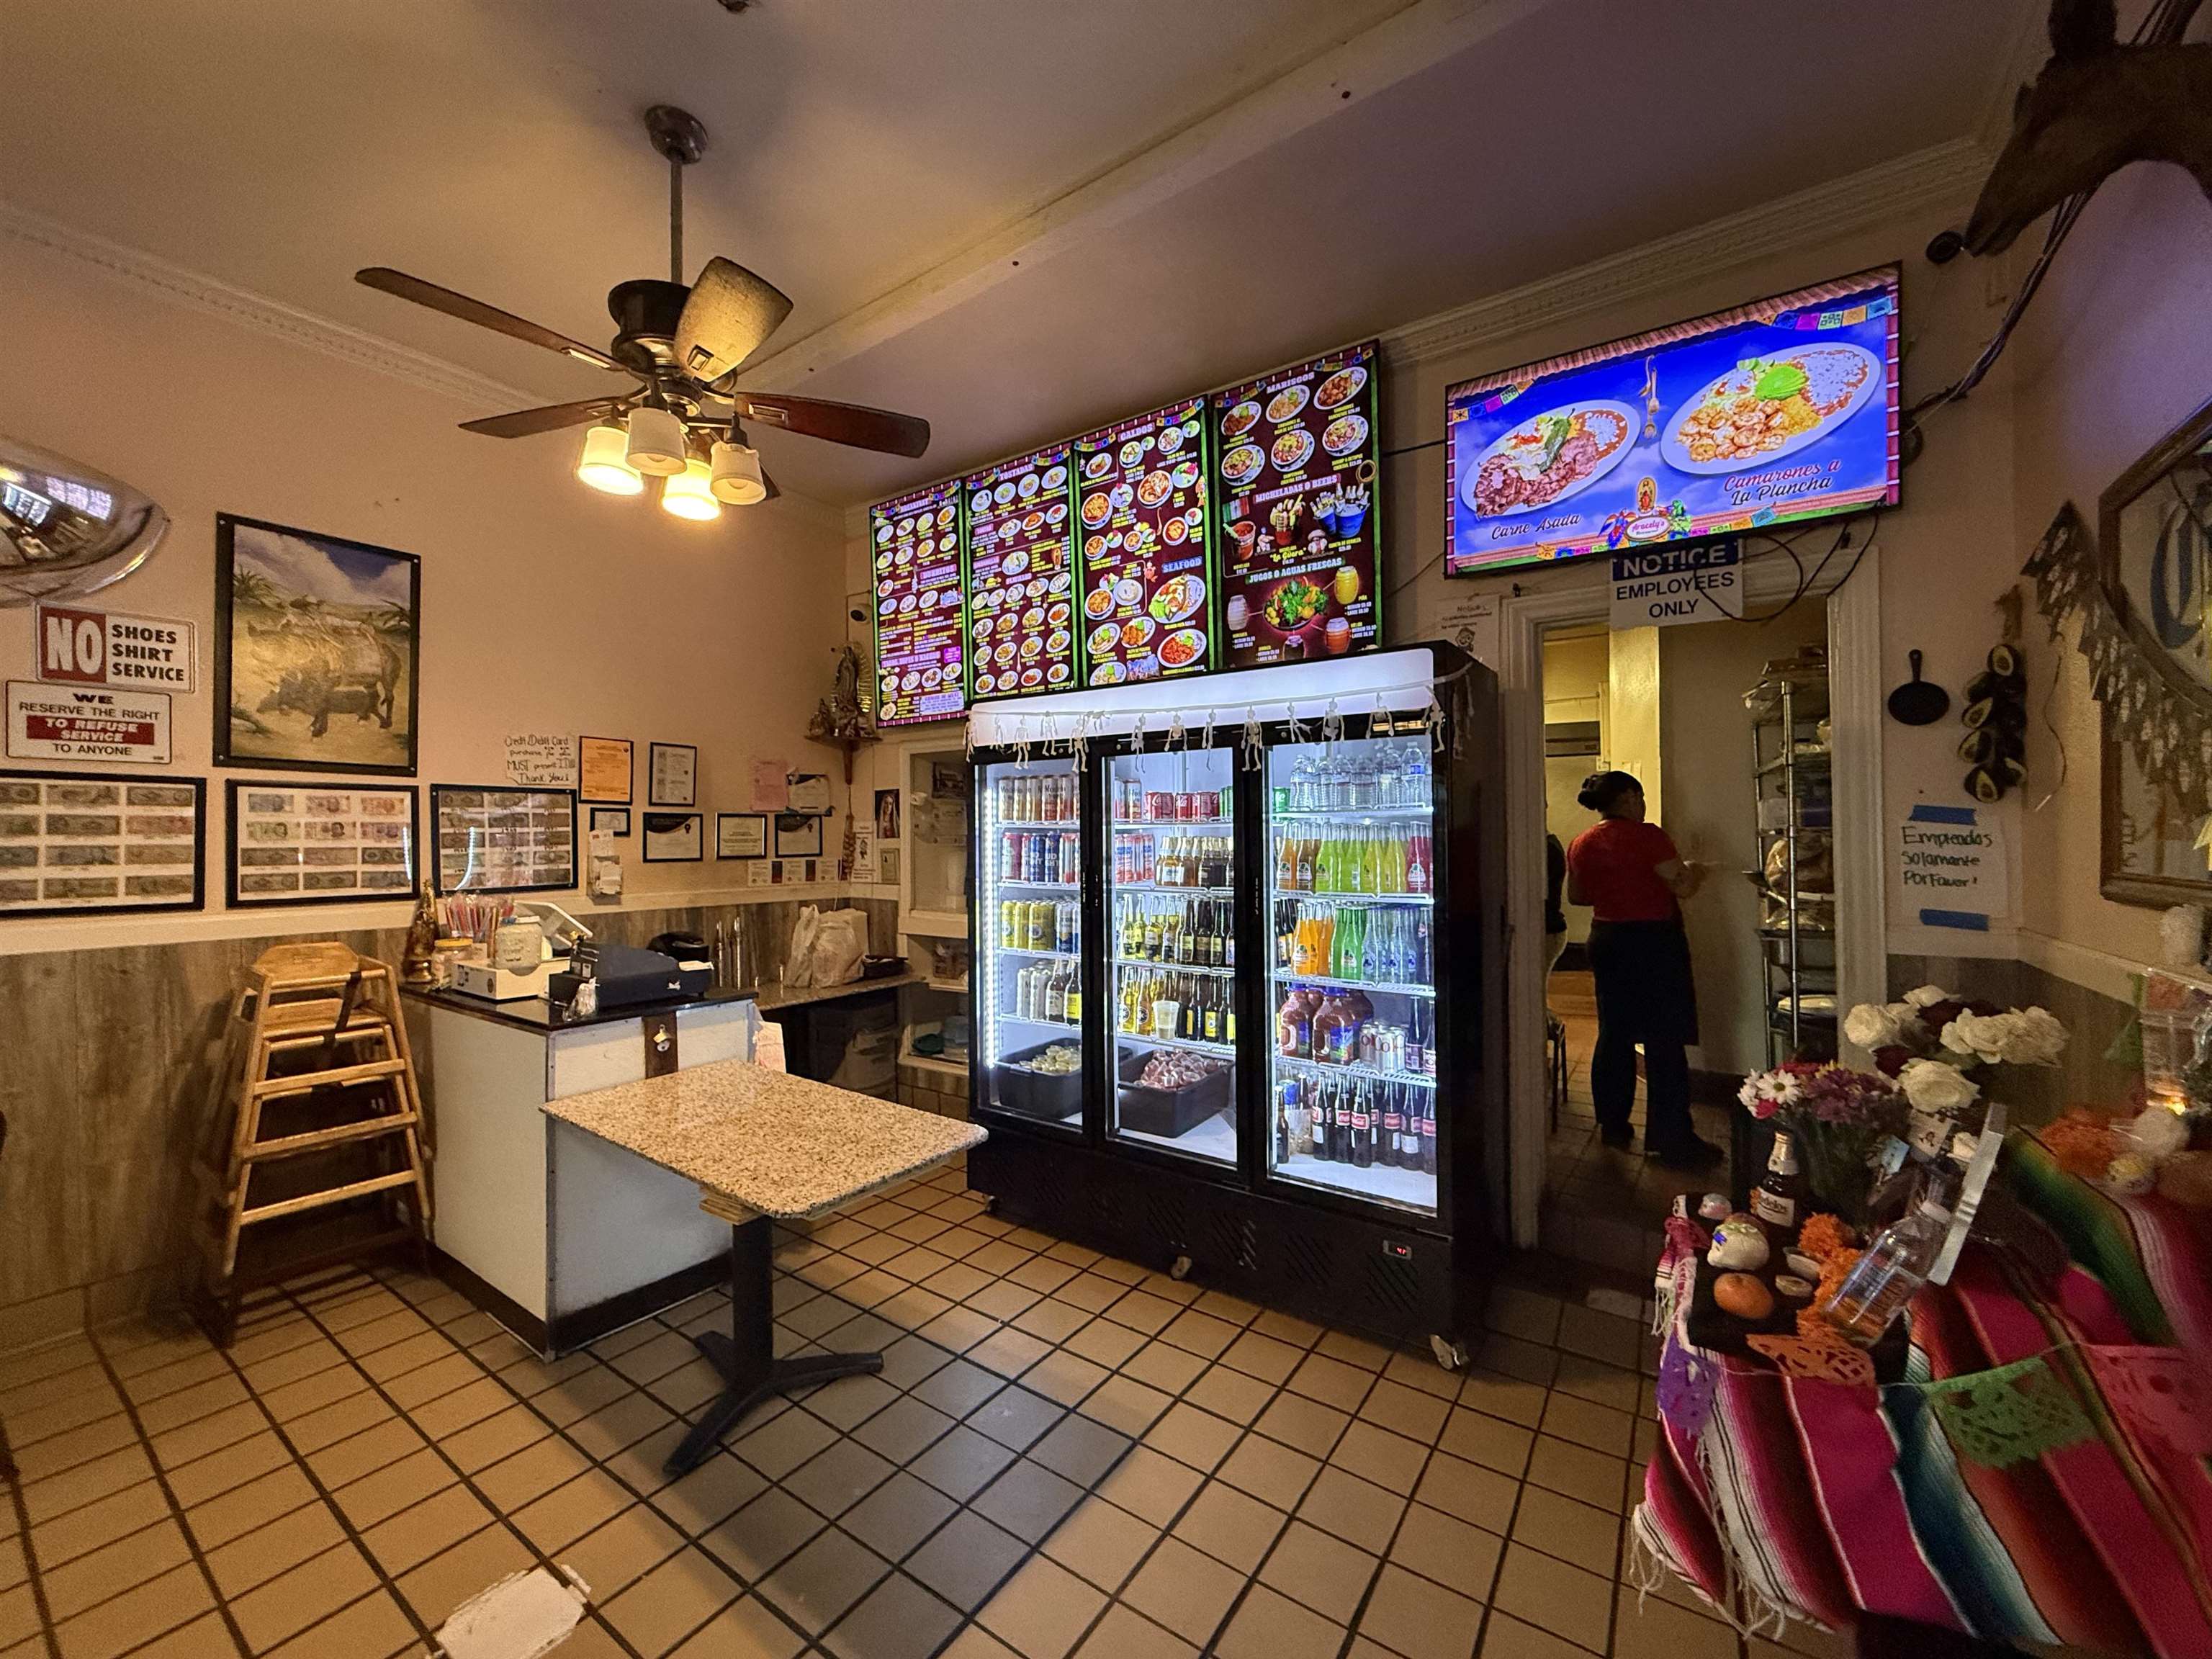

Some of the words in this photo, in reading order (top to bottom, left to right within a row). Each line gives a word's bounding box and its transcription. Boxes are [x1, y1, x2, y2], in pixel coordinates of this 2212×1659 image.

[1267, 372, 1315, 394] MARISCOS
[1120, 423, 1153, 441] CALDOS
[1724, 464, 1820, 492] Camarones
[1828, 460, 1840, 472] a
[1731, 490, 1750, 506] La
[1756, 477, 1831, 501] Plancha
[1492, 523, 1530, 540] Carne
[1535, 513, 1581, 532] Asada
[1163, 557, 1202, 573] SEAFOOD
[1307, 557, 1342, 572] FRESCAS
[1624, 544, 1727, 577] NOTICE
[1617, 572, 1735, 601] EMPLOYEES
[1649, 598, 1699, 618] ONLY
[112, 624, 177, 644] SHOES
[46, 616, 103, 675] NO
[112, 643, 174, 662] SHIRT
[112, 662, 185, 682] SERVICE
[73, 693, 114, 704] WE
[19, 701, 85, 716] RESERVE
[91, 706, 116, 717] THE
[122, 710, 160, 720] RIGHT
[45, 718, 69, 729] TO
[74, 720, 139, 732] REFUSE
[60, 731, 125, 742] SERVICE
[53, 743, 71, 753] TO
[77, 745, 132, 755] ANYONE
[516, 772, 544, 784] Thank
